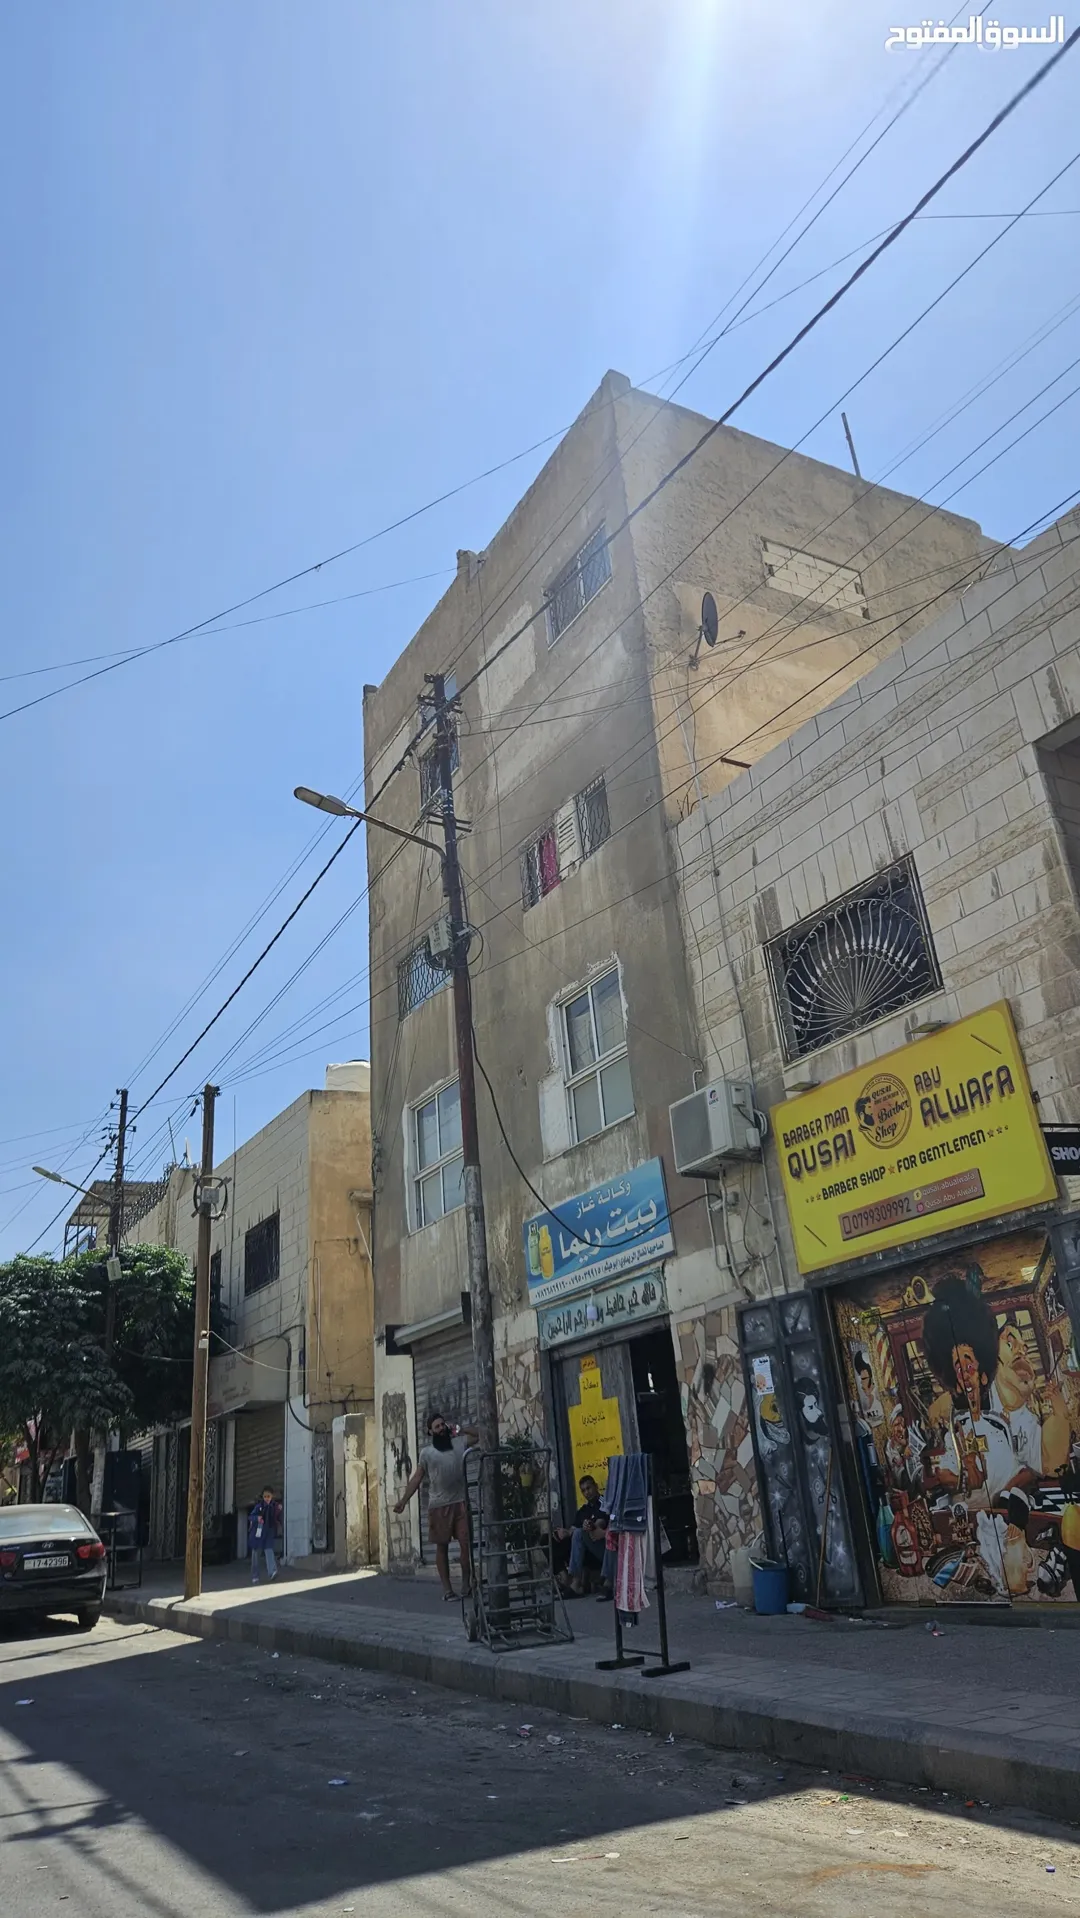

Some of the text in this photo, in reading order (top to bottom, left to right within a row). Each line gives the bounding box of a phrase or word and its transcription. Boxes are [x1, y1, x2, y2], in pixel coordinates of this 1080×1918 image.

[914, 1066, 941, 1096] ABU
[920, 1065, 1016, 1128] ALWAFA
[783, 1106, 850, 1149] BARBER MAN
[878, 1100, 909, 1123] Barber
[875, 1121, 897, 1142] Shop
[788, 1129, 856, 1179] QUSAI
[822, 1129, 986, 1200] BARBER SHOP FOR GENTLEMEN
[1051, 1146, 1080, 1161] SHO
[576, 1180, 631, 1219] وكالة غاز
[851, 1197, 912, 1229] 0799309992
[559, 1198, 657, 1264] بيت ريما
